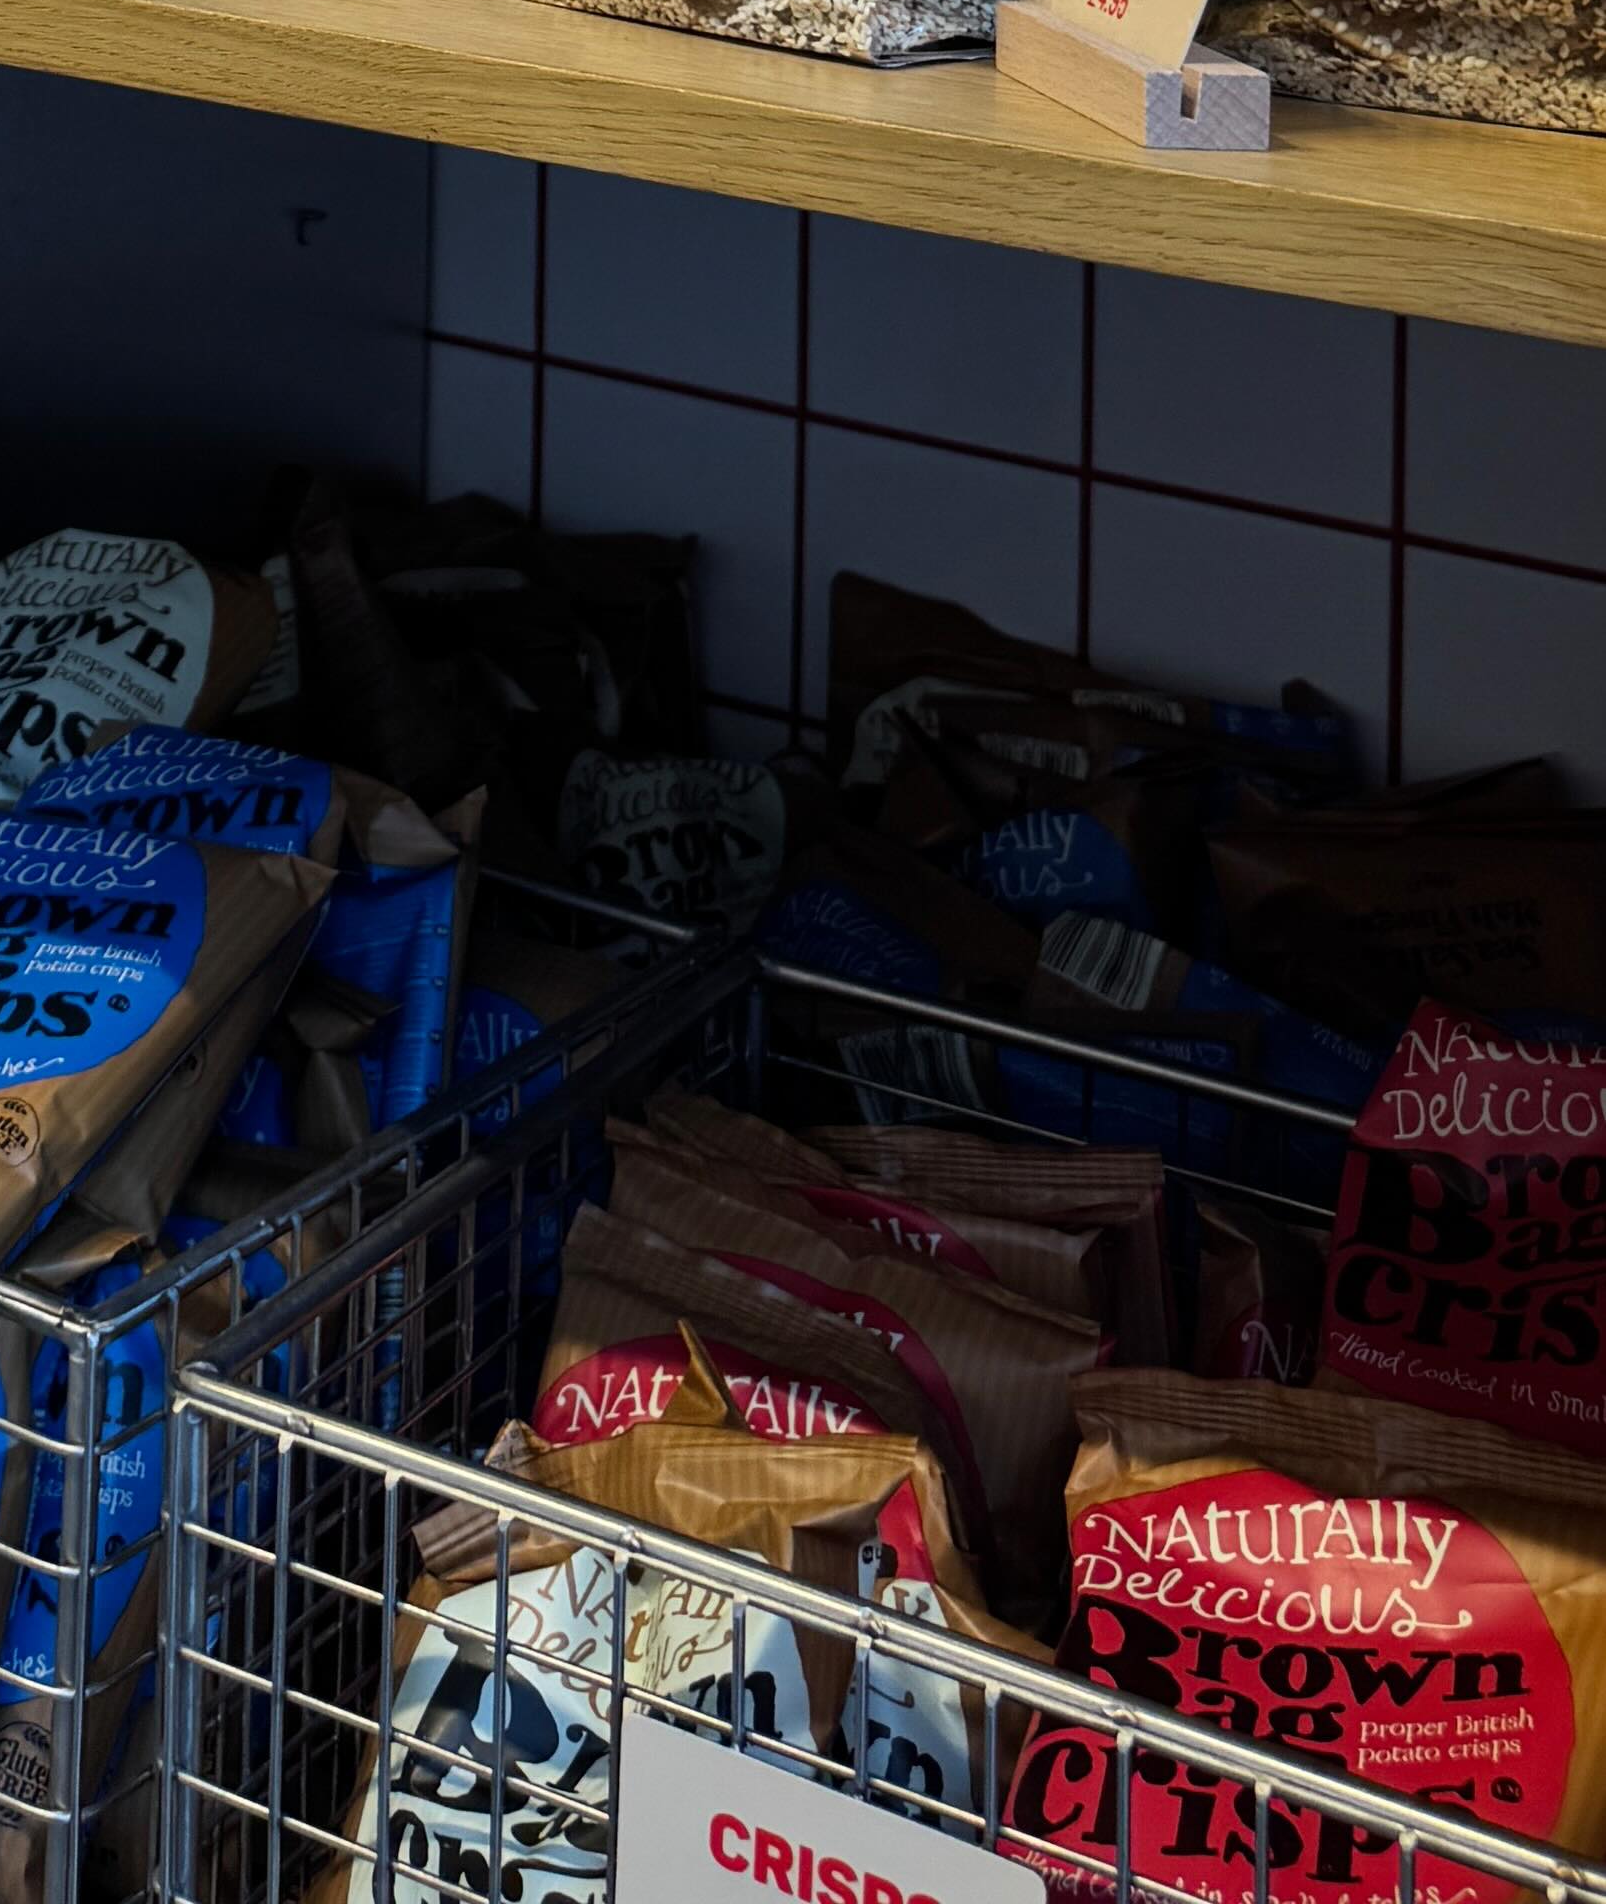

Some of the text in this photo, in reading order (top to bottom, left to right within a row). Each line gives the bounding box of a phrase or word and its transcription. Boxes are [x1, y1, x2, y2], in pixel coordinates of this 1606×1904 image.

[24, 958, 145, 984] potato crisps
[34, 942, 99, 963] proper
[1074, 1554, 1472, 1637] Delicious
[1039, 1595, 1530, 1727] Brown
[1359, 1708, 1534, 1746] proper British
[1358, 1736, 1522, 1769] potato crisps
[709, 1812, 944, 1904] CRISP
